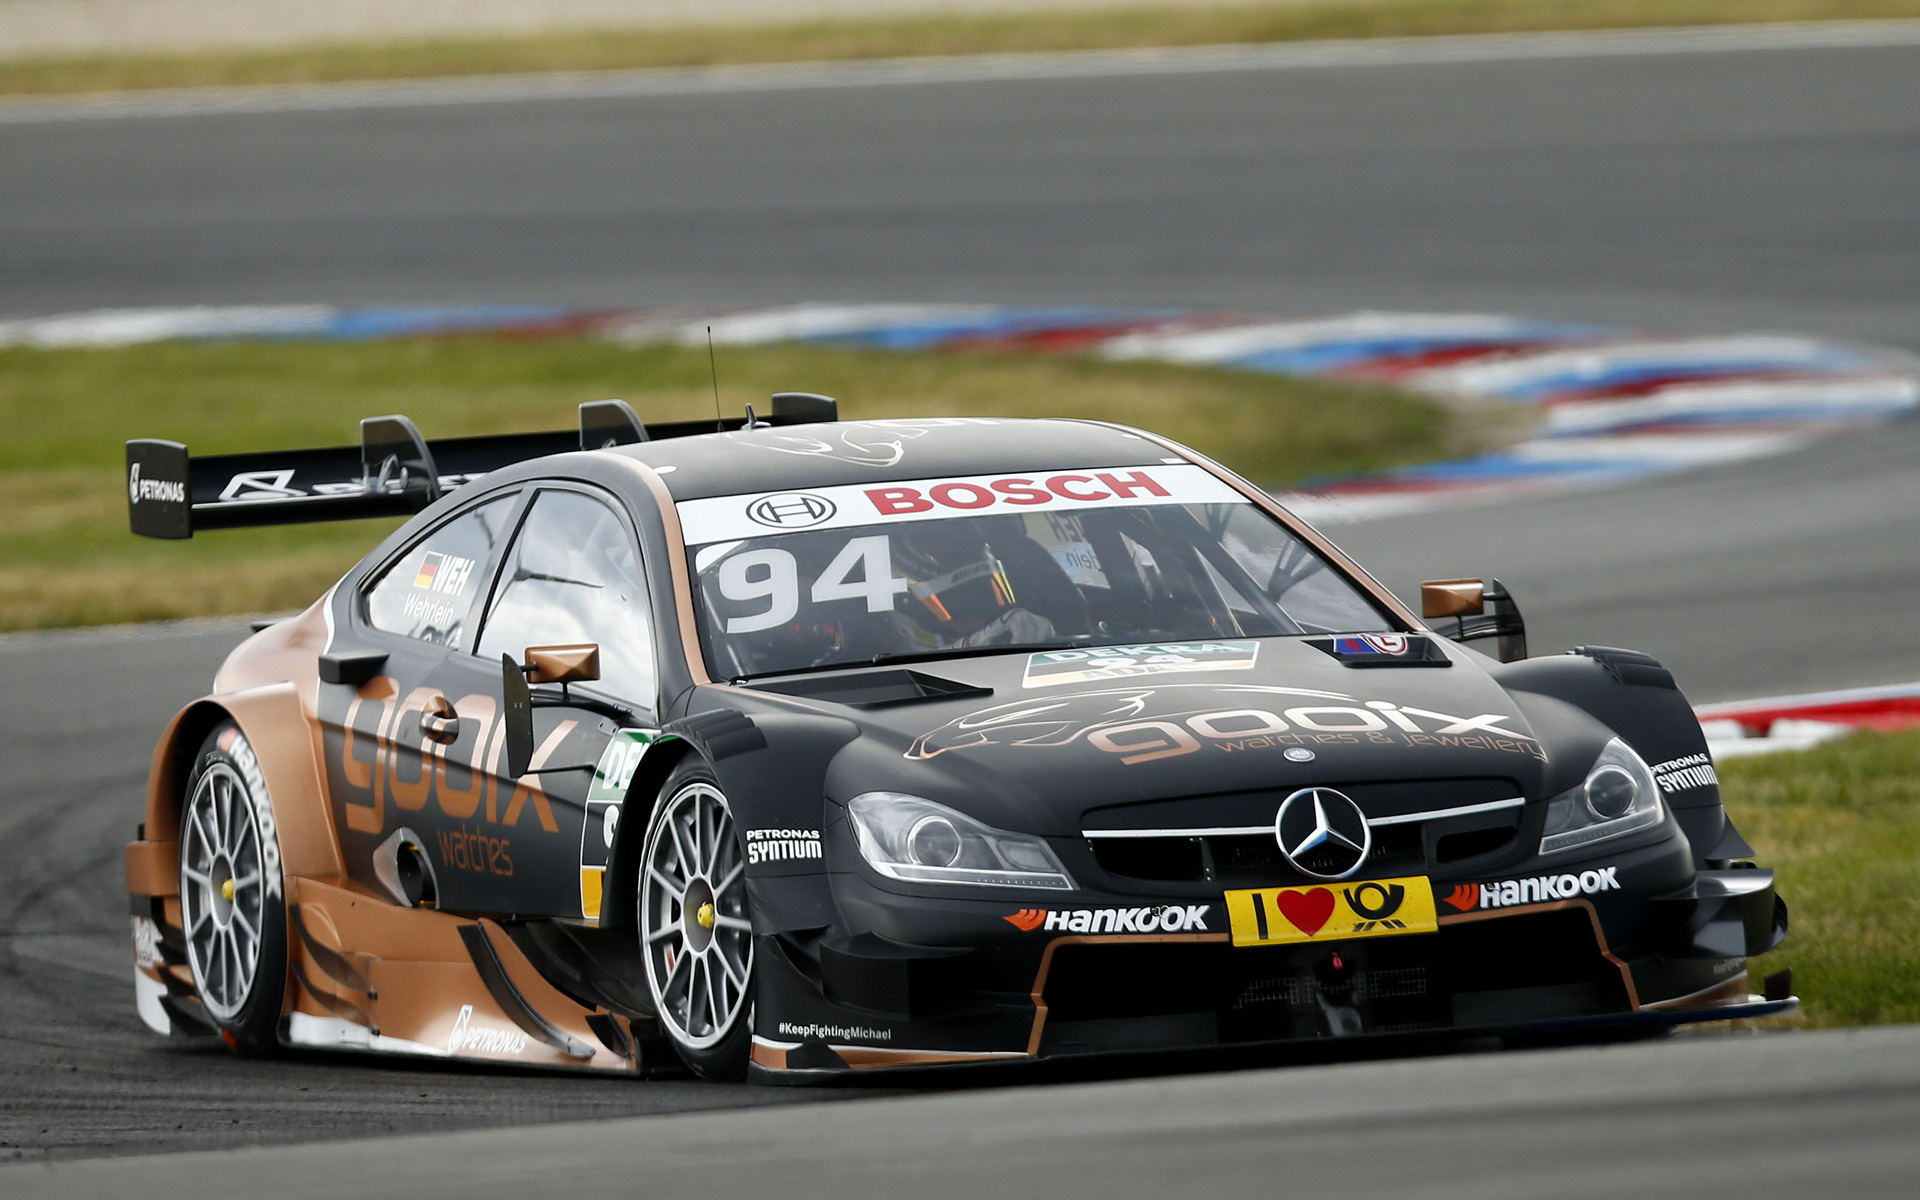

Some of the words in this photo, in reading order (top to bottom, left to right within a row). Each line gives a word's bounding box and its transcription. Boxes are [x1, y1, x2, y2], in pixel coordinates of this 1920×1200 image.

[140, 478, 185, 503] PETRONAS
[864, 471, 1171, 516] BOSCH
[432, 554, 476, 597] WEH
[718, 534, 908, 634] 94
[403, 592, 454, 626] Wehrlein
[1043, 643, 1244, 662] DEKRA
[1087, 700, 1538, 765] gooix
[1214, 731, 1360, 753] watches
[1366, 732, 1395, 744] &
[343, 675, 580, 835] gooix
[1650, 752, 1709, 774] PETRONAS
[1656, 764, 1719, 793] SYNTIUM
[746, 829, 820, 841] PETRONAS
[437, 824, 514, 876] watches
[747, 840, 823, 864] SYNTIUM
[1252, 893, 1269, 940] I
[461, 1026, 529, 1055] PETRONAS
[778, 1022, 892, 1040] #KeepFightingMichael
